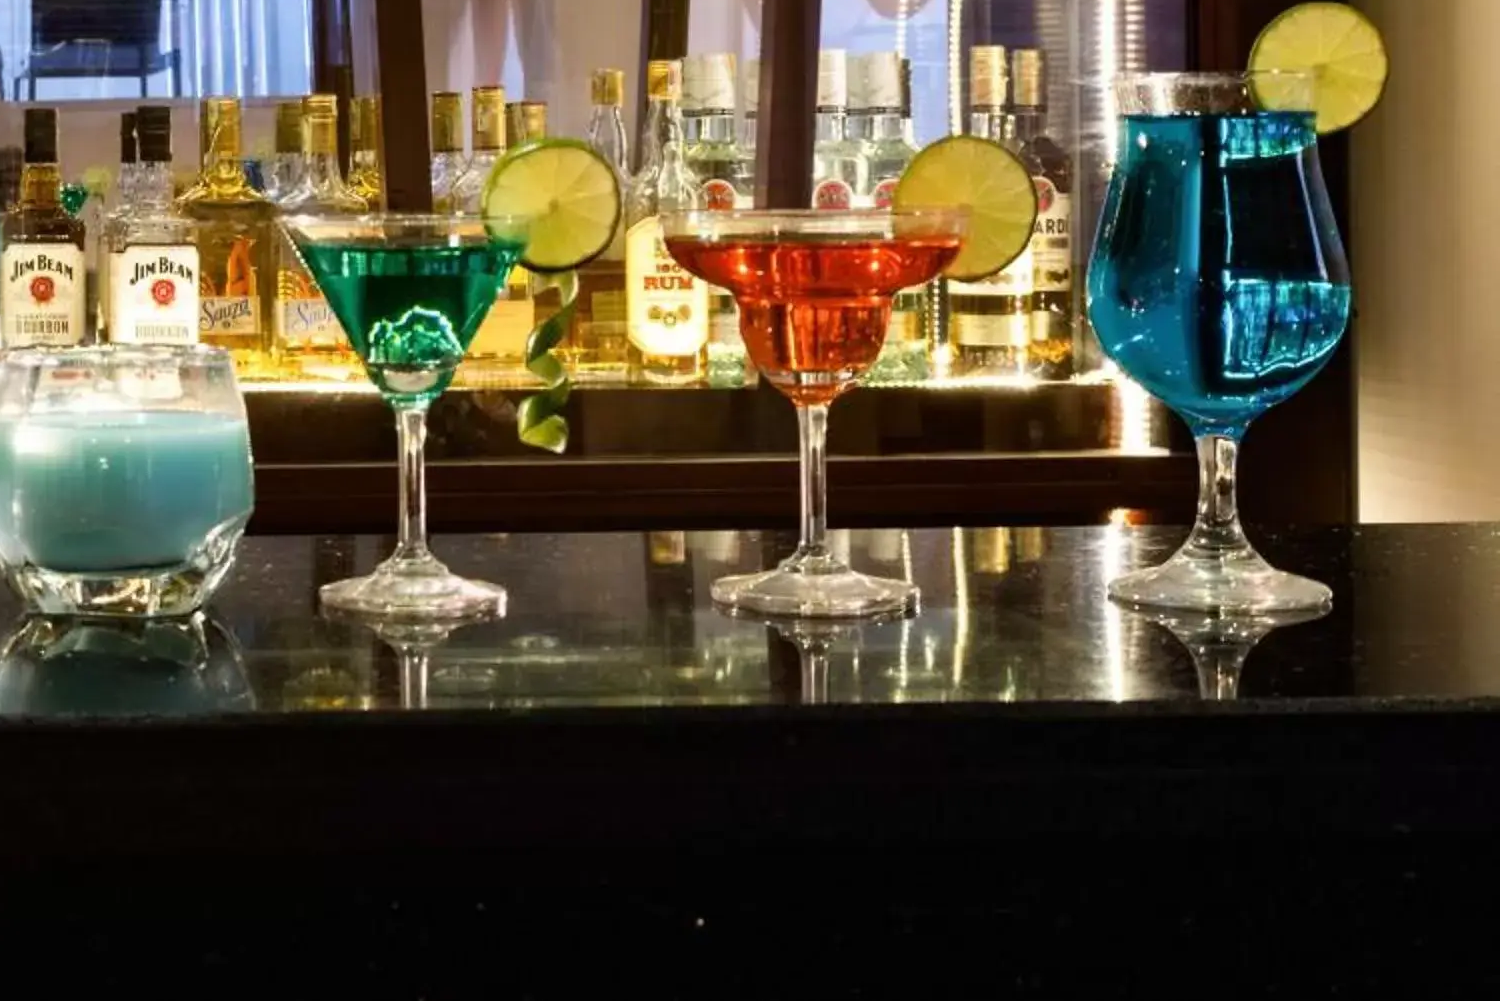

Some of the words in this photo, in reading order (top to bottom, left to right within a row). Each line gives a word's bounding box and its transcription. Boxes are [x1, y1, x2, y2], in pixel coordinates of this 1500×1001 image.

[10, 259, 35, 283] JIM
[37, 254, 73, 282] BEAM
[129, 261, 157, 286] JIM
[159, 256, 193, 284] BEAM
[643, 275, 694, 291] RUM
